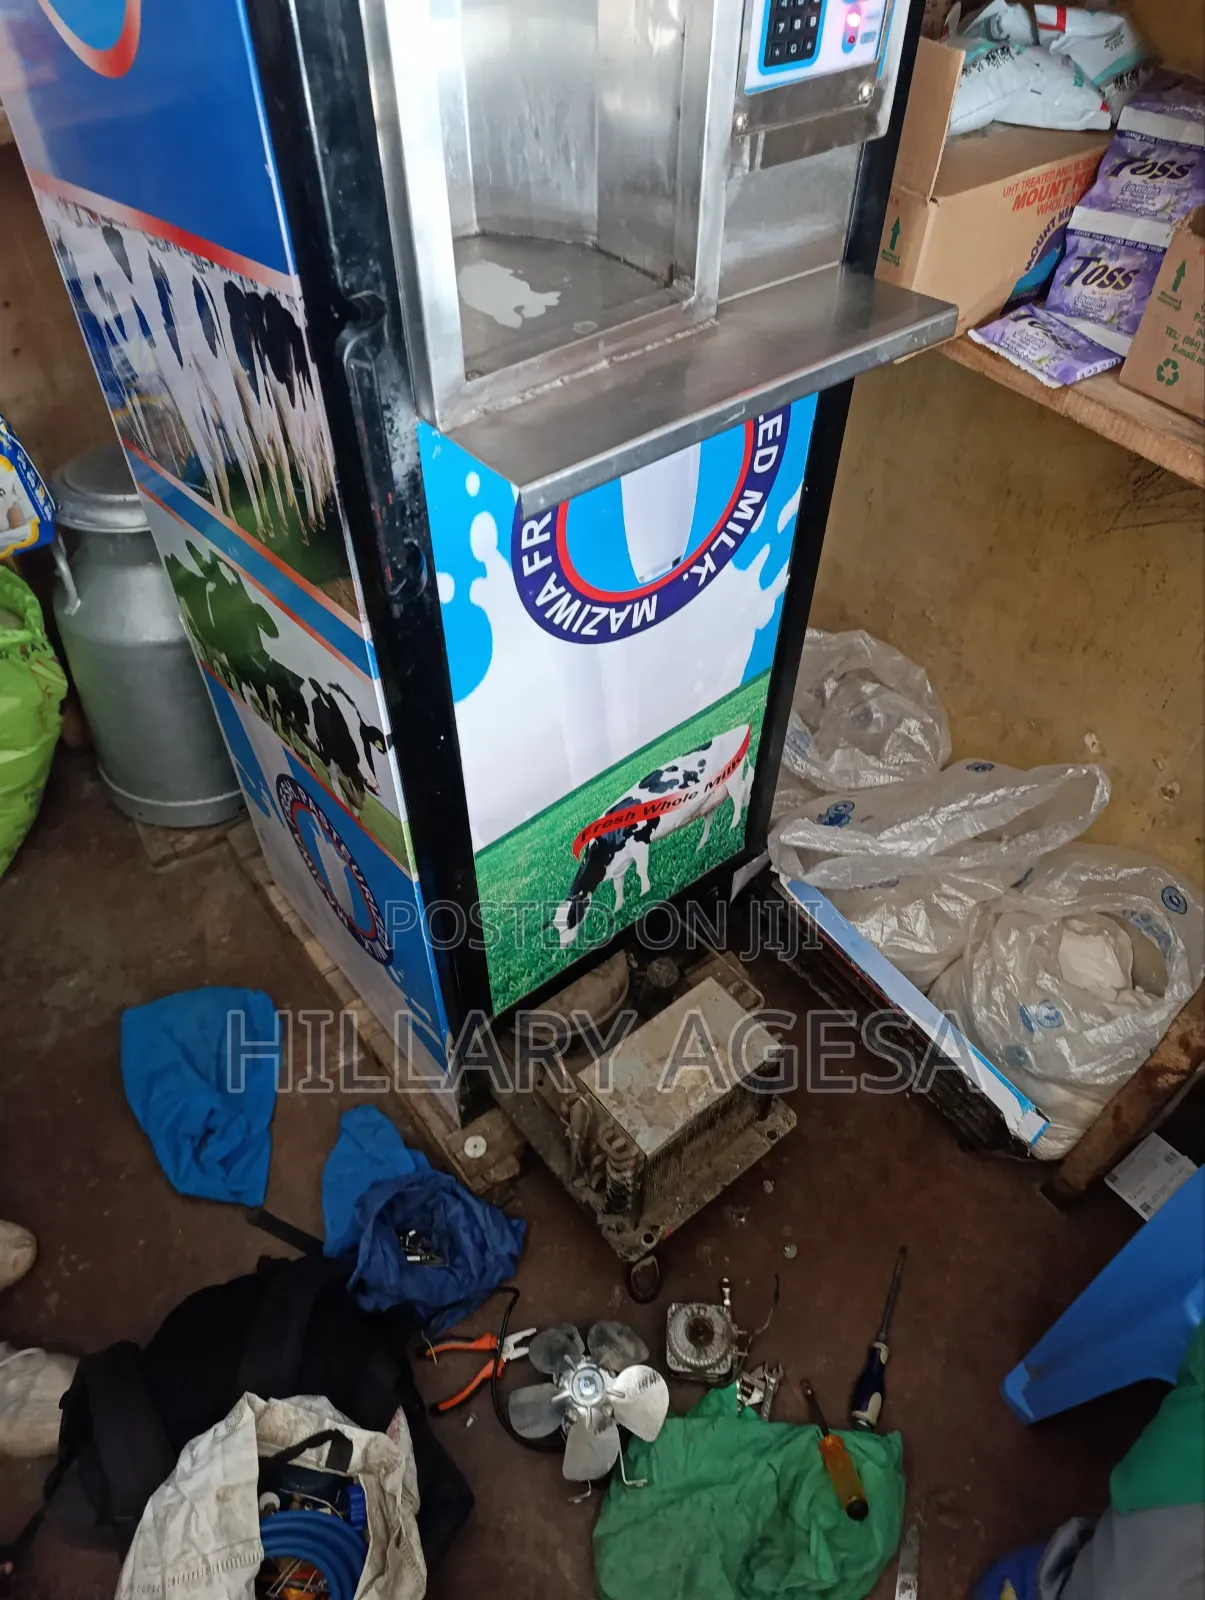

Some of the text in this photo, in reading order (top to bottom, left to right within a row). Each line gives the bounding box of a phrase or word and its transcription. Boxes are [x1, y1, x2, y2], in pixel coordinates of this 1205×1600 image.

[779, 16, 817, 32] 7 8 9
[790, 43, 797, 53] 0
[1003, 184, 1019, 198] UHT
[1021, 170, 1056, 189] TREATED
[1056, 165, 1072, 178] AND
[1012, 178, 1072, 212] MOUNT
[1037, 193, 1071, 217] WHOLE
[1024, 215, 1057, 272] MOUNT
[1125, 239, 1137, 248] SOFT
[1138, 242, 1148, 250] AND
[535, 572, 658, 636] MAZIWA
[579, 757, 742, 843] Fresh Whole Milk
[297, 786, 390, 951] PASTEURIZED
